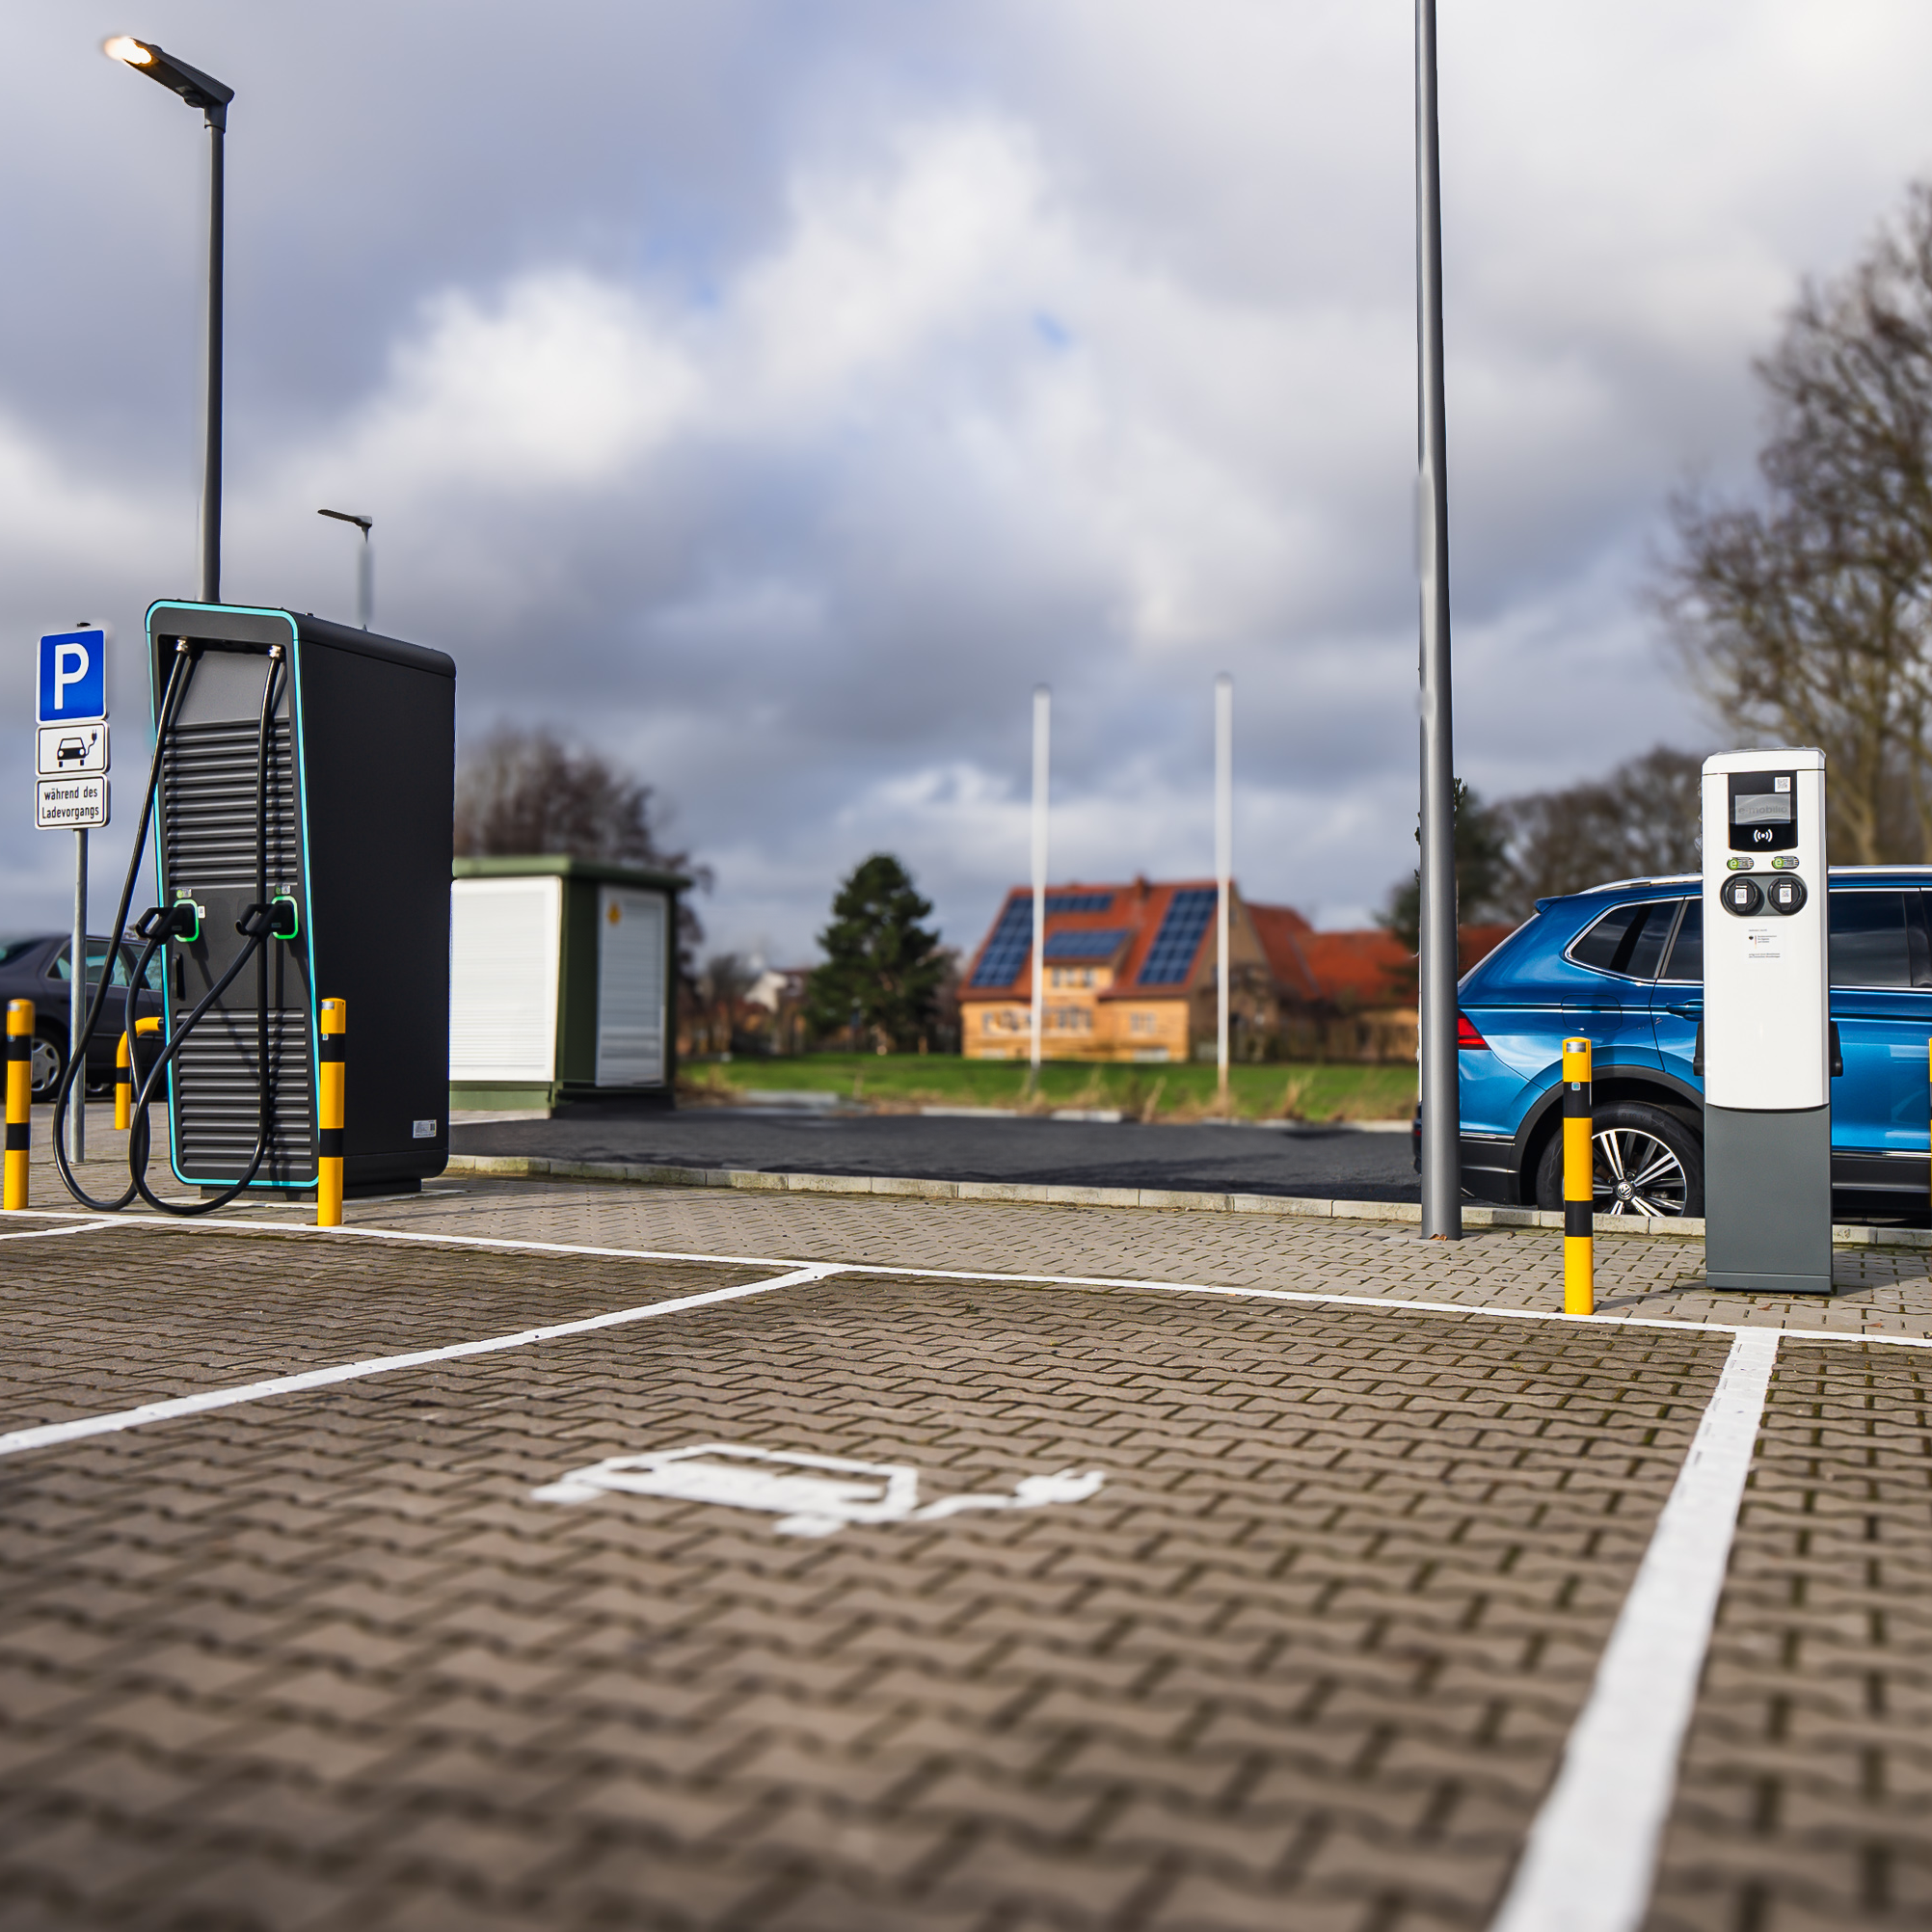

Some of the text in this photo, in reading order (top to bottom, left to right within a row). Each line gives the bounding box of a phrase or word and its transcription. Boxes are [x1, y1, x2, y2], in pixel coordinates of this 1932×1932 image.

[52, 643, 90, 711] P
[43, 785, 98, 801] während des
[41, 805, 99, 820] Ladevorgangs
